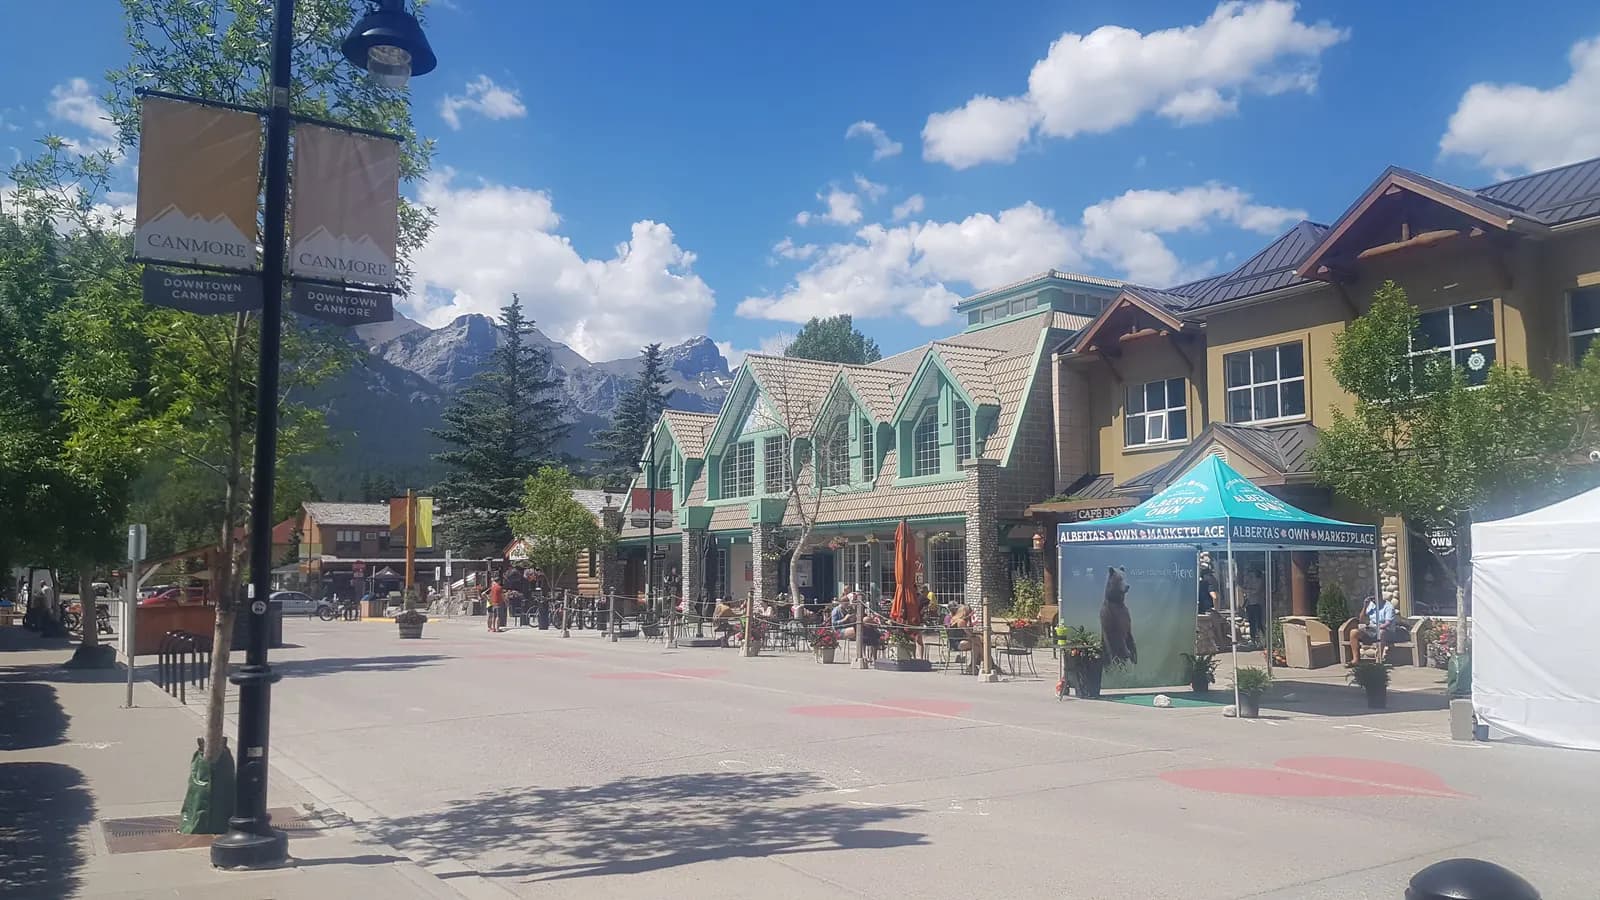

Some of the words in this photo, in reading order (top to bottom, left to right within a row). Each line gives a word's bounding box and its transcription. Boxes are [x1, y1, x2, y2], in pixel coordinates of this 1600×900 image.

[147, 233, 248, 258] CANMORE
[300, 252, 387, 276] CANMORE
[164, 278, 241, 292] DOWNTOWN
[172, 290, 236, 303] CANMORE
[307, 291, 377, 308] DOWNTOWN
[314, 303, 370, 318] CANMORE
[1060, 529, 1106, 542] ALBERTA'S
[1114, 530, 1139, 541] OWN
[1148, 526, 1225, 539] MARKETPLACE
[1232, 525, 1280, 539] ALBERTA'S
[1287, 528, 1310, 541] OWN
[1317, 530, 1375, 545] MARKETPLACE
[1430, 537, 1452, 547] OWN
